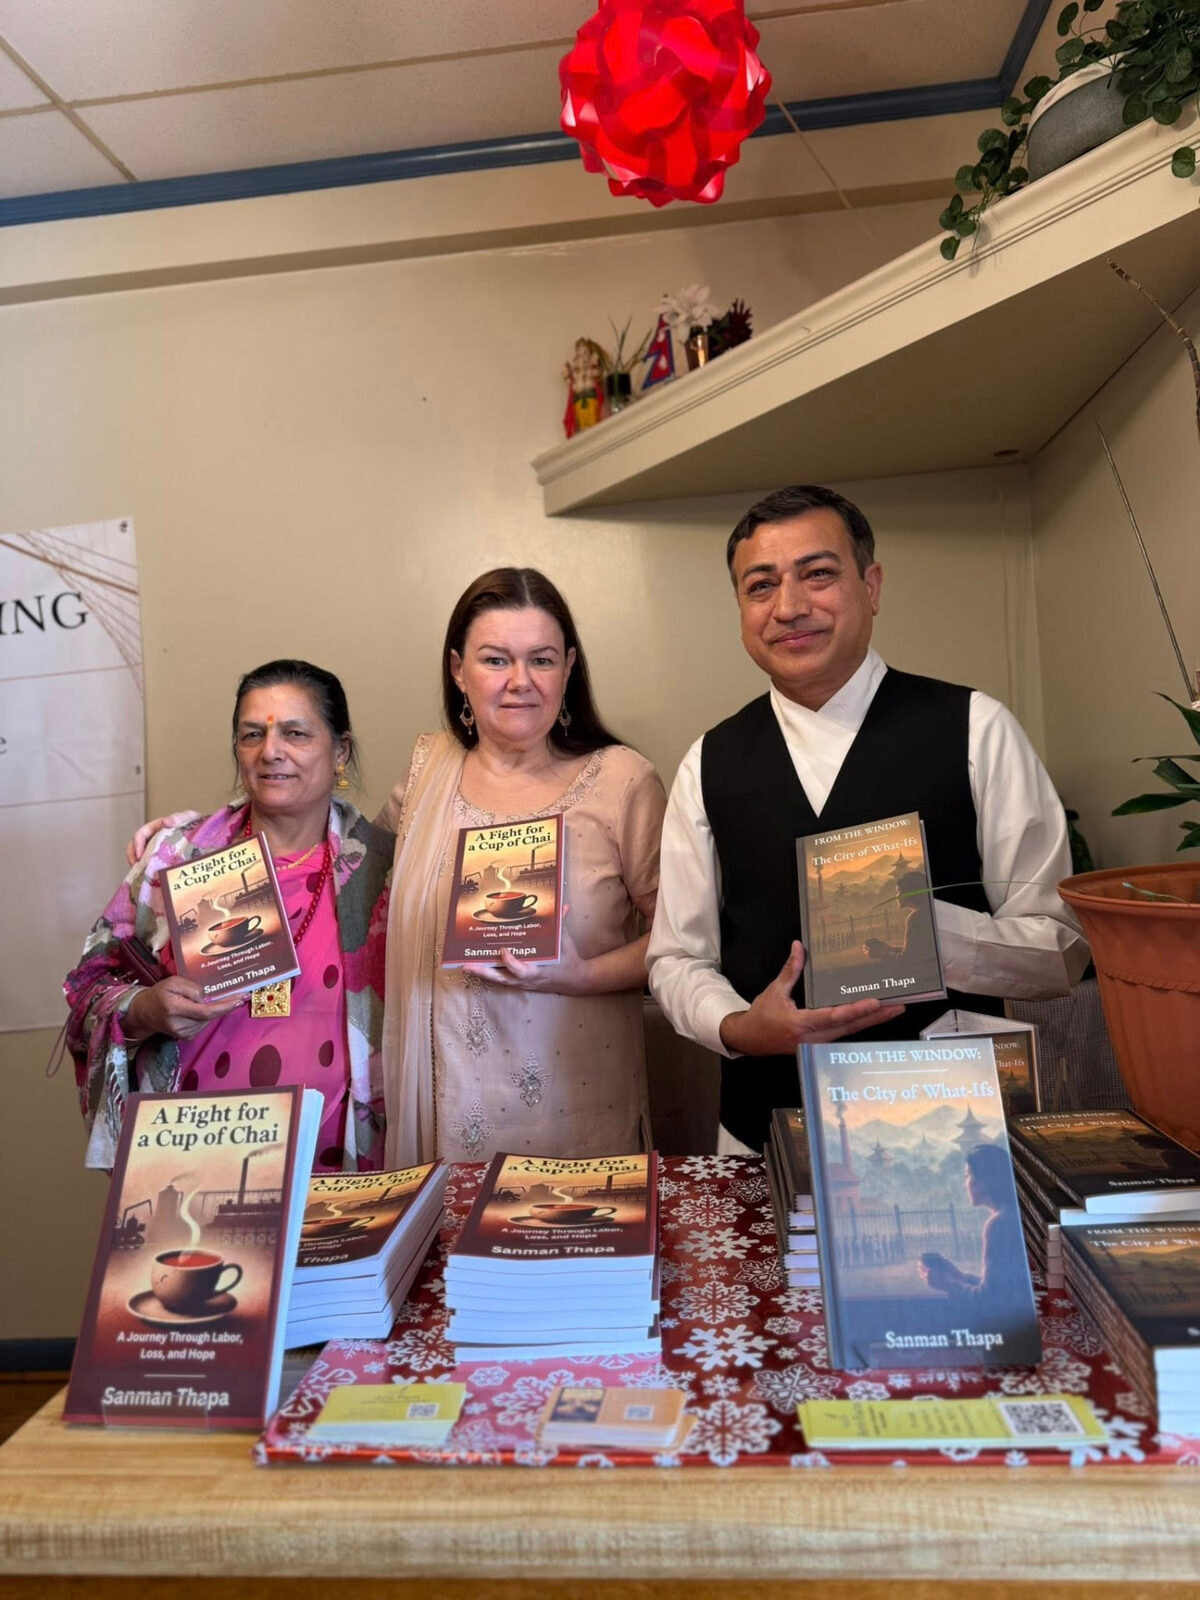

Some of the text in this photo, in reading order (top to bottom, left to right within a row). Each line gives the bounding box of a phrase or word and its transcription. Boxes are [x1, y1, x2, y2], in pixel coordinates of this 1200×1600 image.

[476, 826, 544, 841] A Fight for
[815, 819, 911, 846] FROM THE WINDOW:
[479, 842, 504, 851] Cup
[507, 838, 521, 847] of
[522, 833, 551, 845] Chai
[812, 837, 918, 866] The City of What-Ifs
[174, 853, 257, 891] a Cup of Chai
[179, 848, 247, 879] A Fight for
[507, 948, 537, 956] Thapa
[204, 965, 276, 994] Sanman Thapa
[840, 977, 916, 995] Sanman Thapa
[830, 1048, 981, 1064] FROM THE WINDOW:
[999, 1058, 1025, 1067] hat-Ifs
[828, 1082, 994, 1104] The City of What-Ifs
[151, 1102, 269, 1129] A Fight for
[138, 1123, 279, 1151] a Cup of Chai
[525, 1166, 563, 1175] Cup
[593, 1164, 638, 1173] Chai
[542, 1160, 592, 1169] Fight
[334, 1177, 382, 1185] Fight
[388, 1170, 415, 1179] for
[378, 1173, 420, 1186] Chai
[304, 1254, 349, 1263] Thapa
[492, 1246, 615, 1256] Sanman Thapa
[117, 1332, 244, 1345] A Journey Through Labor,
[886, 1329, 1004, 1350] Sanman Thapa
[140, 1349, 216, 1362] Loss, and Hope
[103, 1387, 230, 1410] Sanman Thapa
